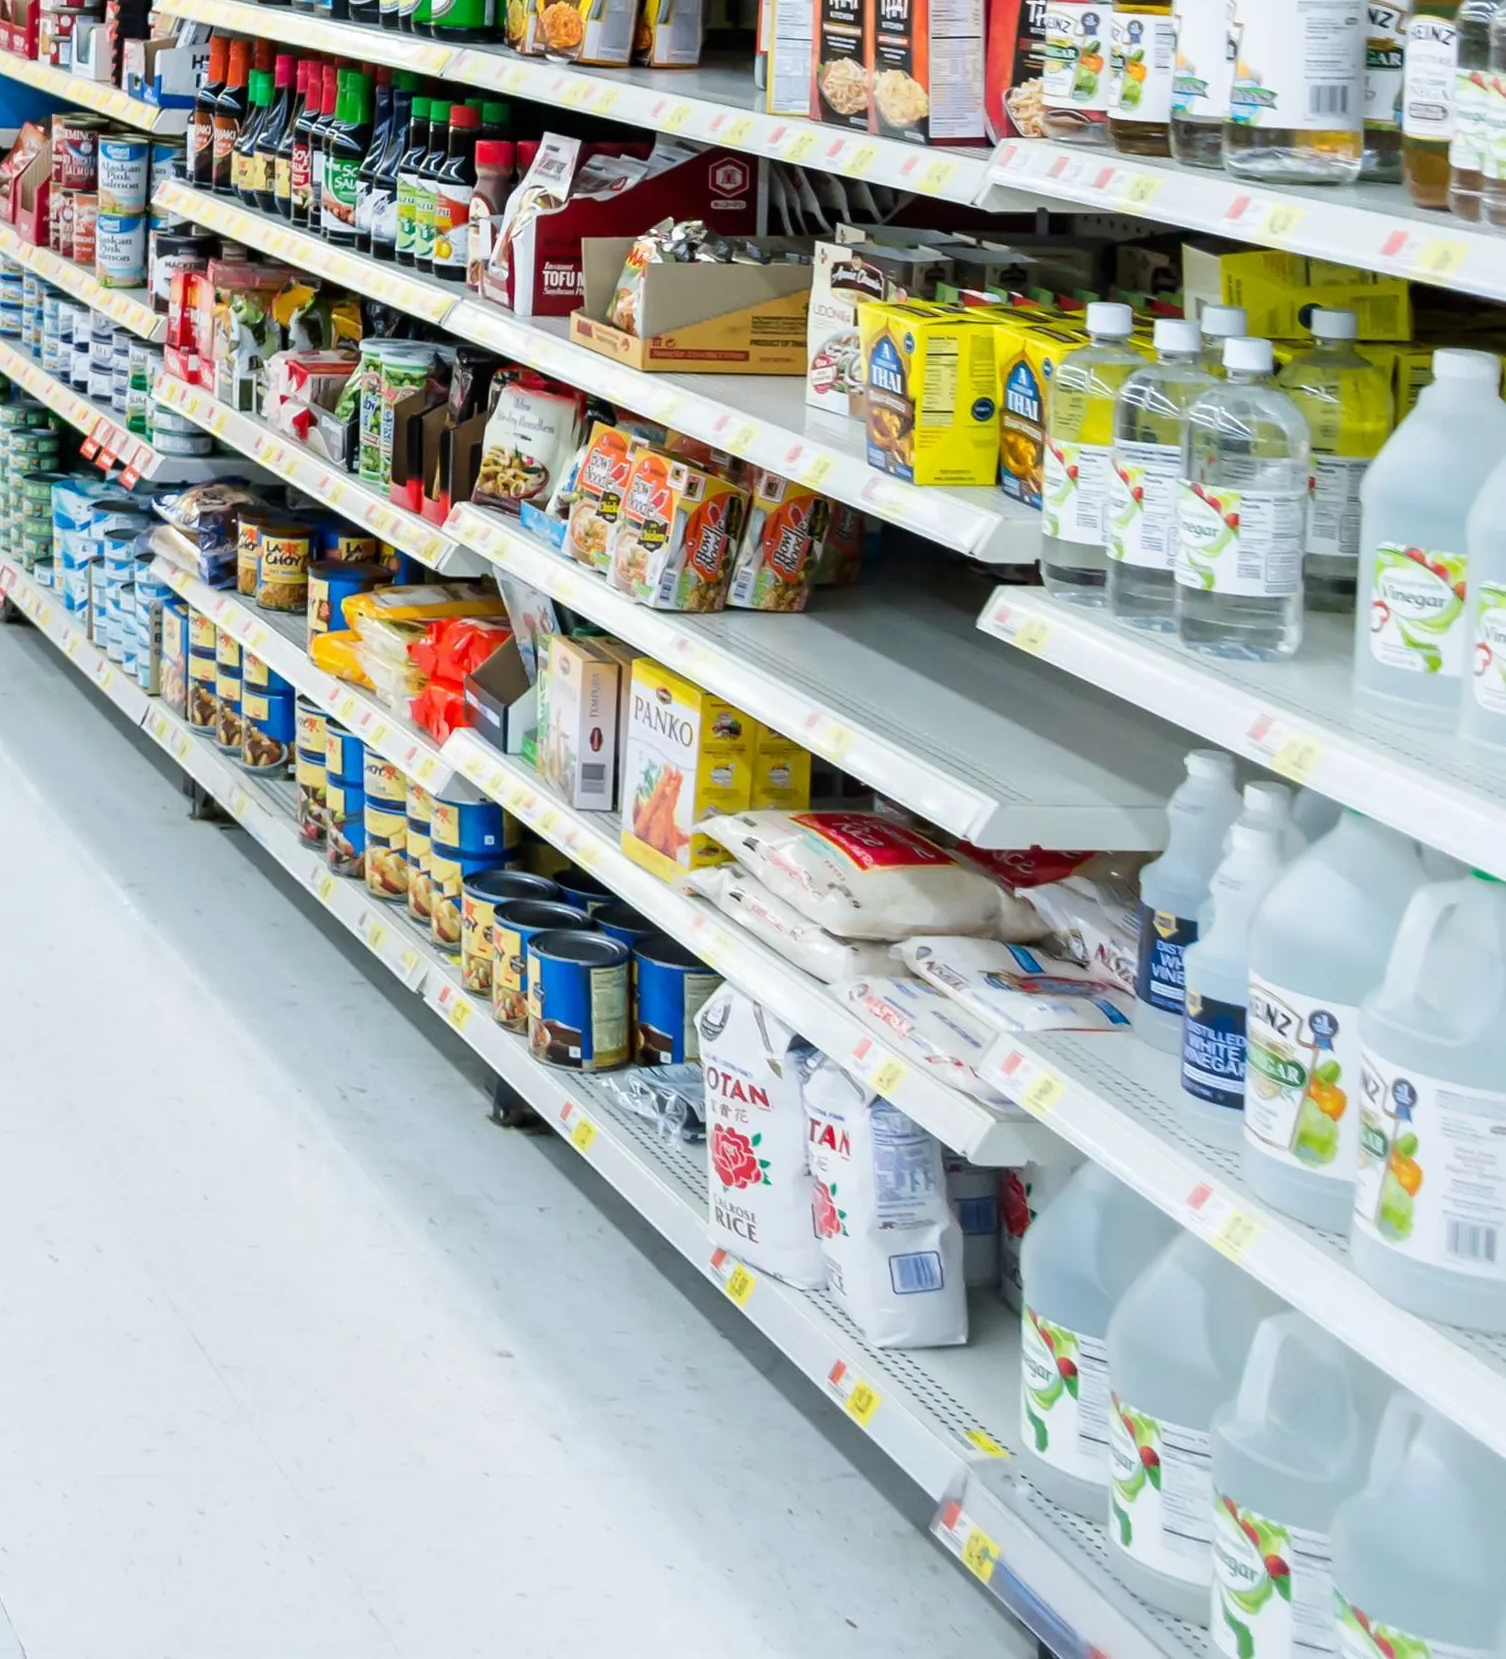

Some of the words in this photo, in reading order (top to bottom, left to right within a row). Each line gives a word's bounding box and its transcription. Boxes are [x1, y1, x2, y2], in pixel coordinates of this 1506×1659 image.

[542, 271, 575, 288] TOFU
[870, 364, 903, 395] THAI
[1004, 387, 1040, 423] THAI
[264, 552, 303, 567] CHOY
[265, 539, 282, 553] LA
[1378, 584, 1448, 614] Vinegar
[633, 700, 695, 749] PANKO
[705, 1065, 772, 1112] OTAN
[714, 1206, 760, 1244] RICE
